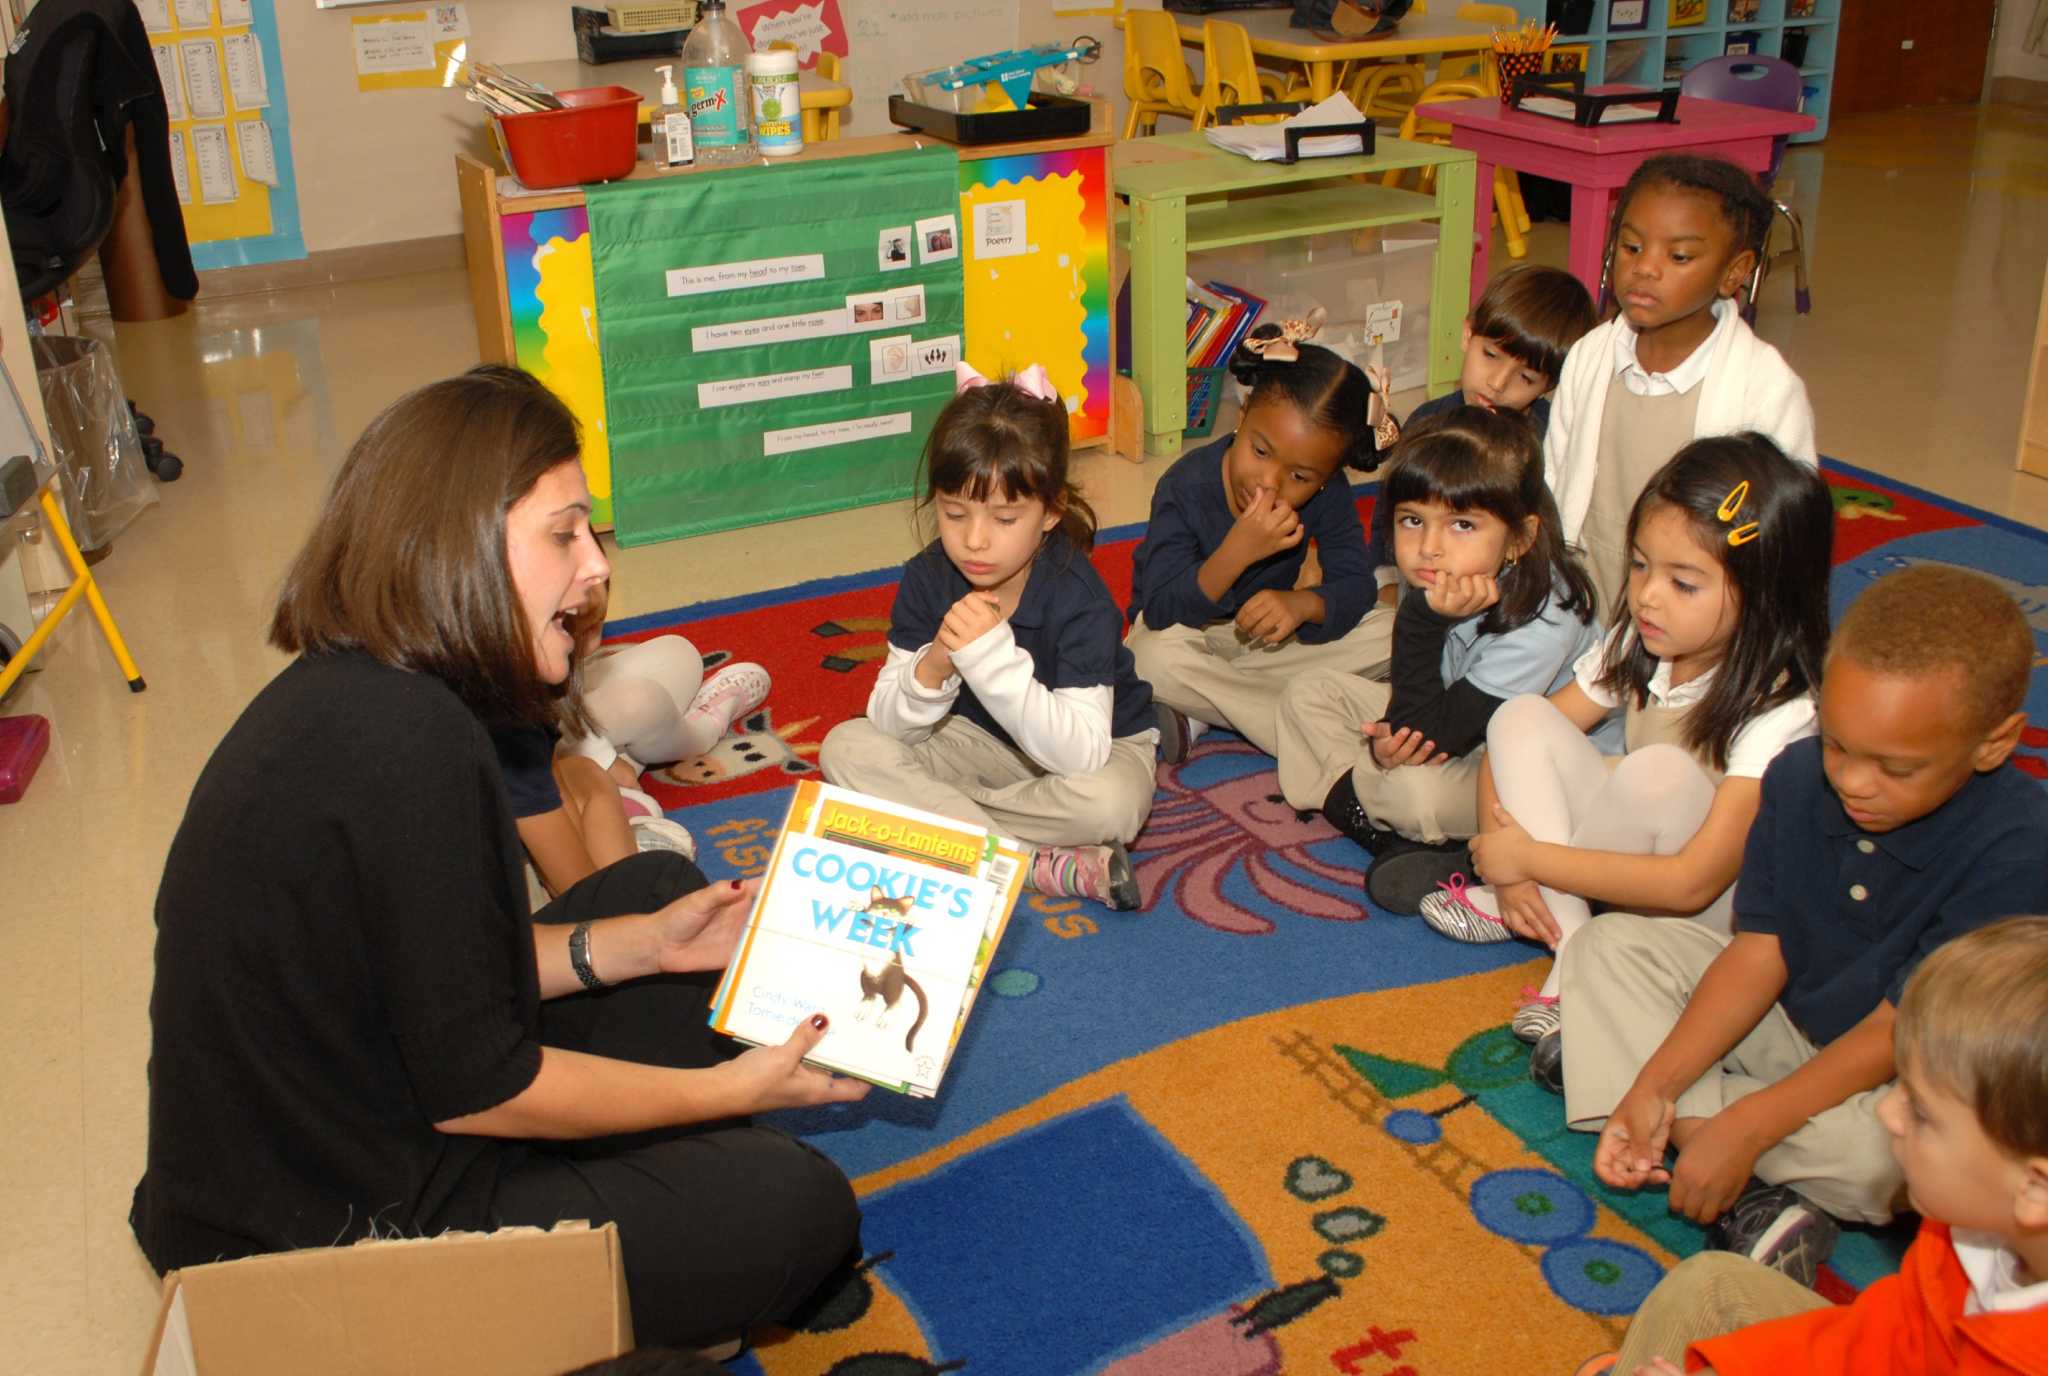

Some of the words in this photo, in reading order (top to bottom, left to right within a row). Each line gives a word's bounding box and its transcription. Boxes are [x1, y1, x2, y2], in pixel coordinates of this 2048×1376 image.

[759, 124, 792, 137] WIPES
[718, 271, 736, 281] from
[738, 271, 748, 281] my
[750, 267, 768, 279] head
[710, 330, 728, 338] have
[761, 324, 776, 333] and
[791, 319, 806, 328] little
[772, 375, 783, 384] and
[823, 807, 977, 865] Jack-o-Lanterns
[791, 847, 973, 919] COOKIE'S
[811, 899, 923, 957] WEEK
